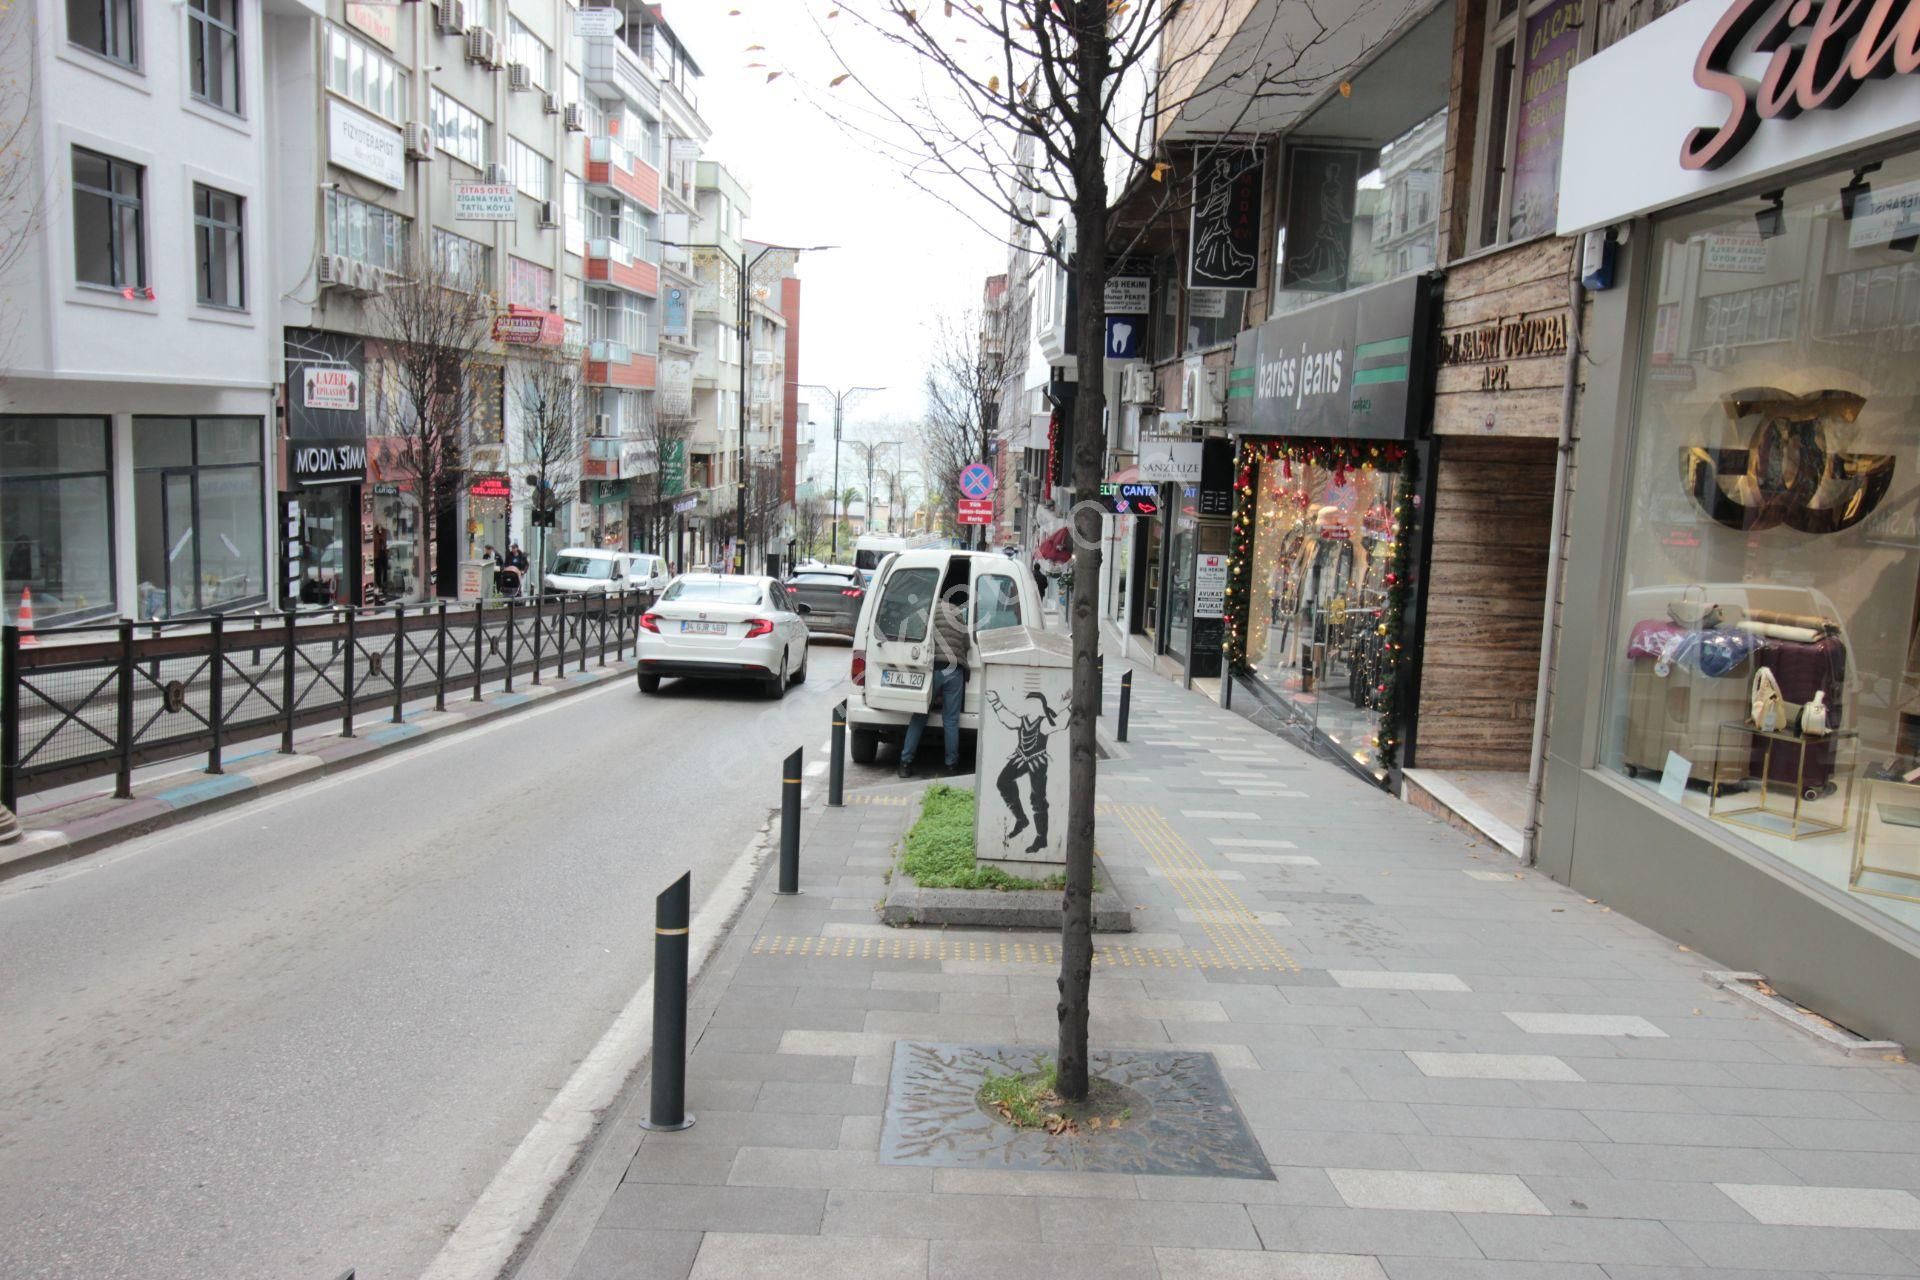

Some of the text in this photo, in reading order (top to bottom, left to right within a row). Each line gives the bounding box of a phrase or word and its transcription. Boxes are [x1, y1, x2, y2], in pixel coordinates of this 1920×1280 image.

[487, 187, 511, 195] OTEL
[316, 371, 348, 386] LAZER
[1258, 342, 1343, 410] bariss jeans
[1482, 365, 1510, 392] APT.
[297, 447, 337, 473] MODA
[886, 672, 895, 683] 61
[910, 673, 923, 685] 120
